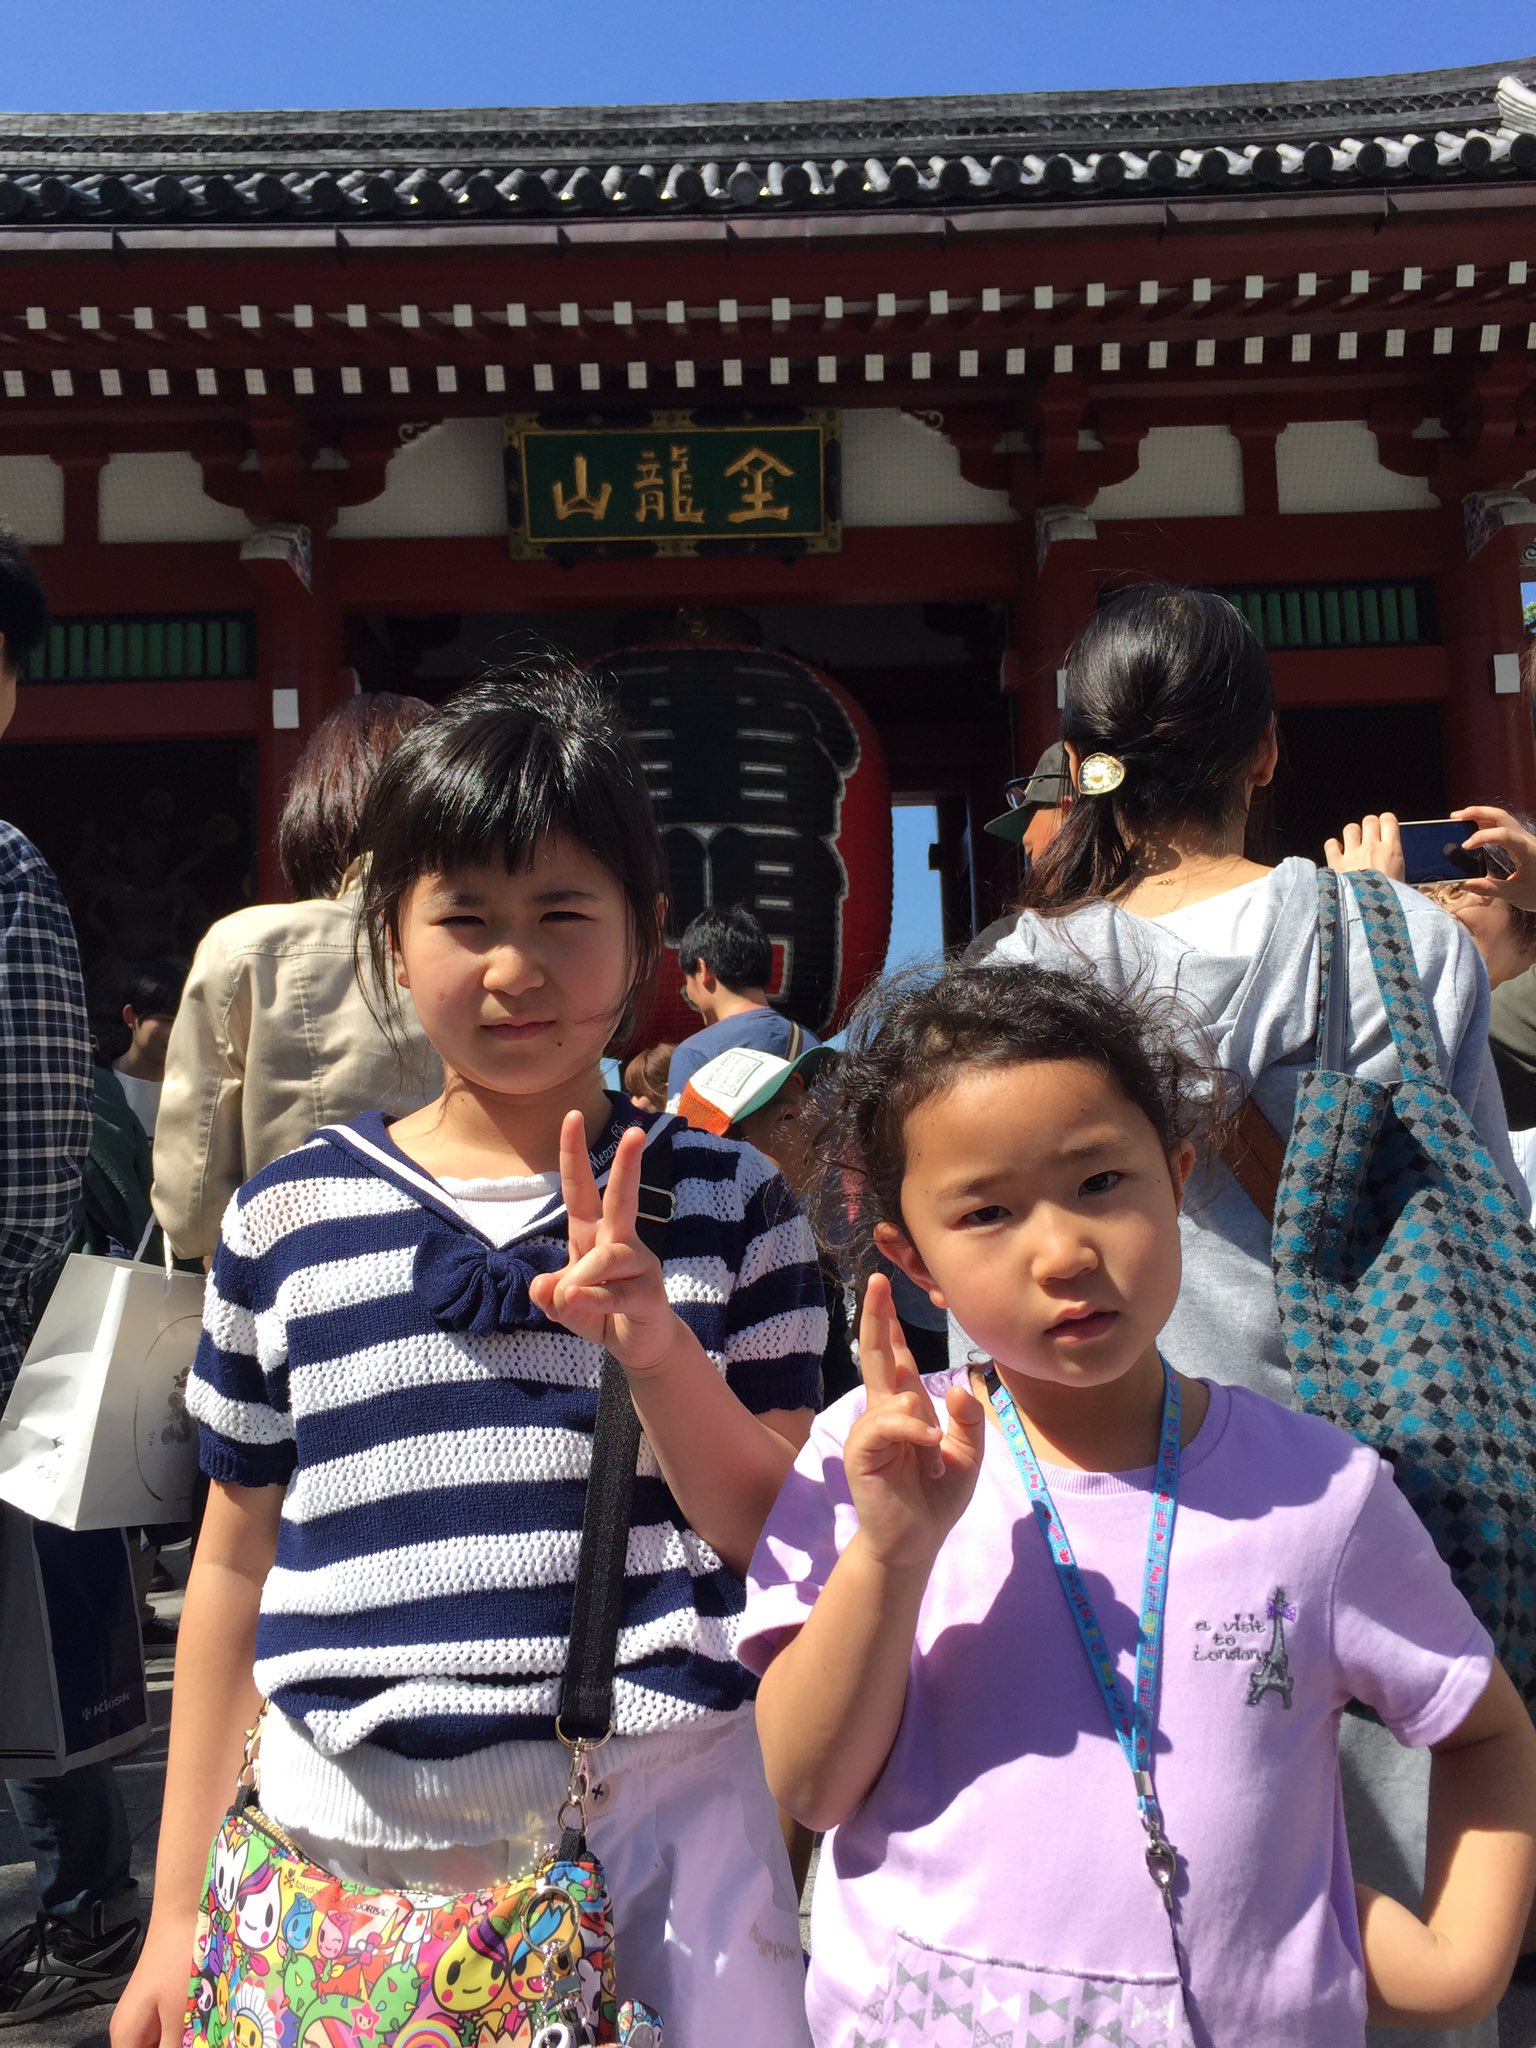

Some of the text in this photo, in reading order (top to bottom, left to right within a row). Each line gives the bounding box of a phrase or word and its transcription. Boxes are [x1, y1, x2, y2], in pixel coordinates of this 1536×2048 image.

[1195, 1613, 1266, 1633] a visit
[1212, 1633, 1236, 1646] to
